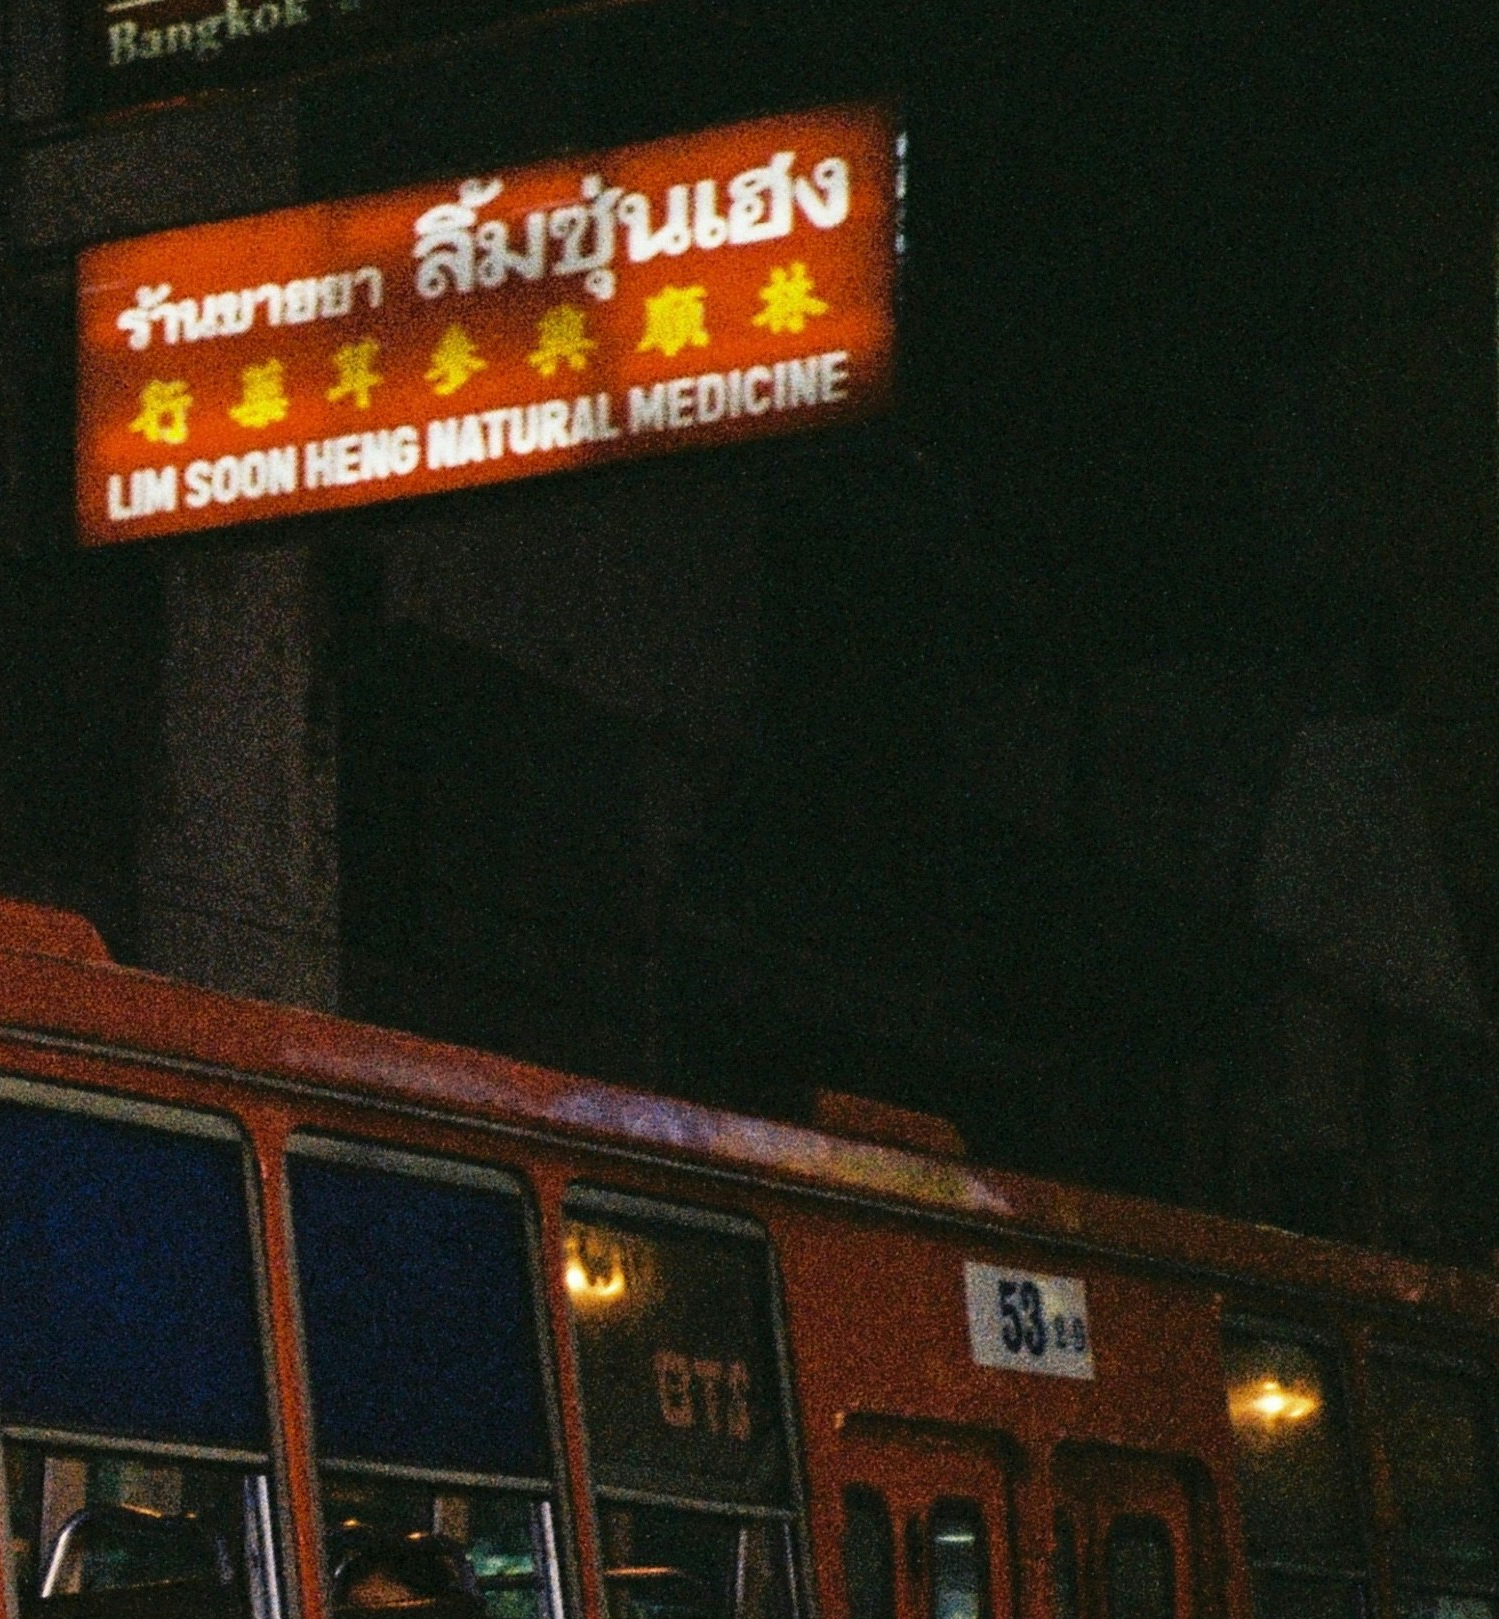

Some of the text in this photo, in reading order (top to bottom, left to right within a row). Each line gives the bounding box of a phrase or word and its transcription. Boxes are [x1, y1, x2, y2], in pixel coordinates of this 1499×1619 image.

[106, 0, 311, 67] Bangkok
[106, 349, 851, 520] LIM SOON HENG NATURAL MEDICINE
[998, 1280, 1047, 1356] 53
